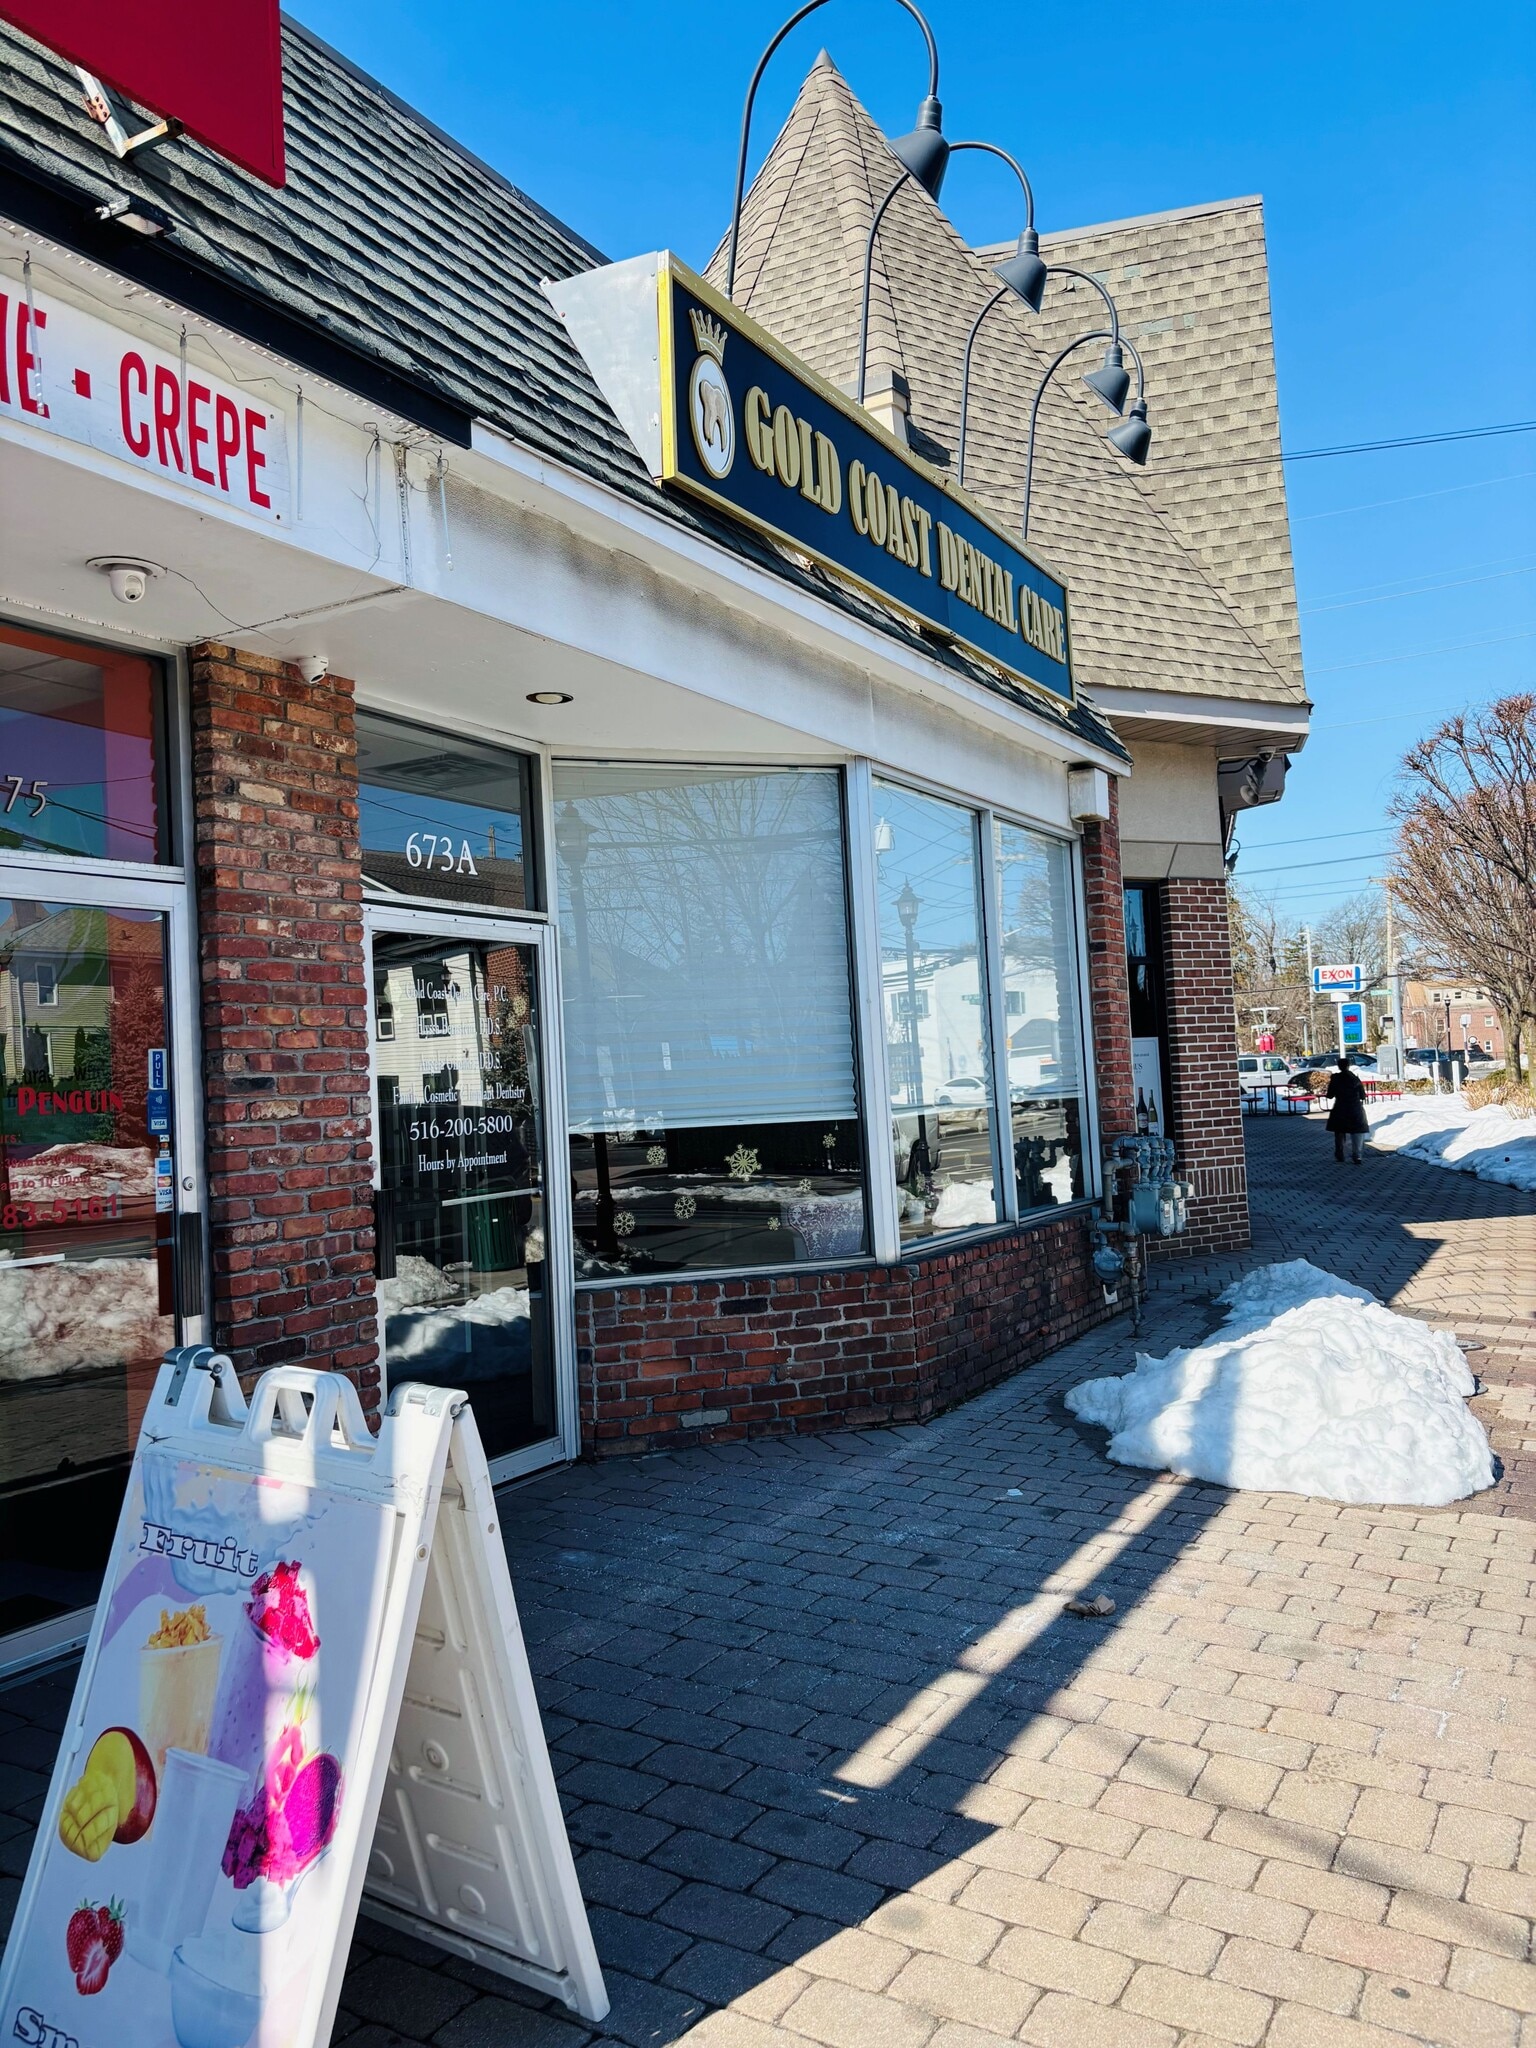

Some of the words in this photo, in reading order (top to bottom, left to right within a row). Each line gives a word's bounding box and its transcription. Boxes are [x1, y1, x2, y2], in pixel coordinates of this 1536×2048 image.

[120, 351, 271, 509] CREPE
[745, 386, 842, 515] GOLD
[848, 459, 933, 578] COAST
[938, 520, 1019, 634] DENTAL
[1019, 584, 1066, 664] CARE
[406, 832, 478, 875] 673A
[1321, 969, 1353, 982] EXXON
[427, 981, 449, 1000] Coast
[17, 1087, 124, 1116] PENGUIN
[424, 1085, 458, 1104] Cosmetic
[496, 1082, 526, 1103] Dentistry
[410, 1115, 513, 1140] 516-200-5800
[419, 1154, 444, 1172] Hours
[446, 1149, 456, 1173] by
[458, 1150, 508, 1172] Appointment
[3, 1193, 118, 1229] 83-5161
[139, 1522, 258, 1577] Fruit
